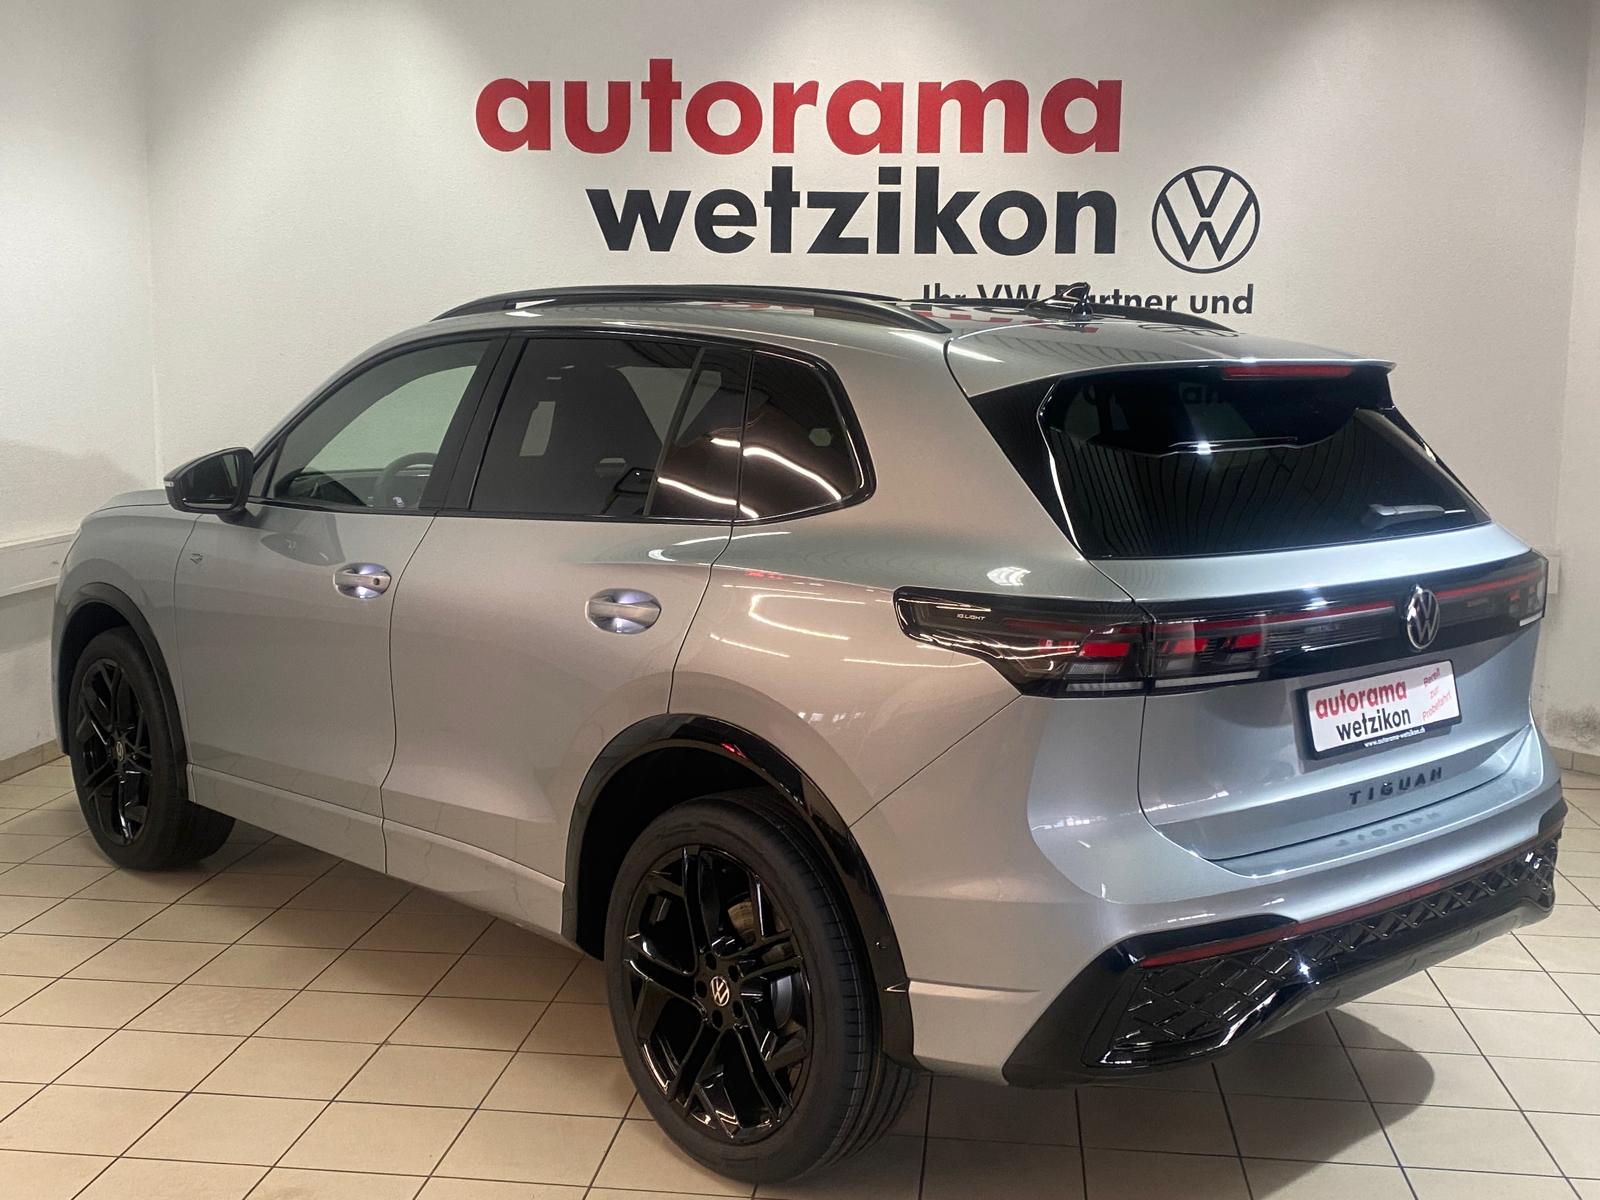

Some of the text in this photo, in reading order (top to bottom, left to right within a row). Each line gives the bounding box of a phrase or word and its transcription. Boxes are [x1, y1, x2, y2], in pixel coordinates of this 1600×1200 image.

[475, 58, 1122, 155] autorama
[585, 166, 1117, 257] wetzikon
[1190, 283, 1254, 314] und
[1315, 681, 1408, 719] autorama
[1336, 707, 1411, 742] wetzikon
[1349, 767, 1442, 805] TIGUAN
